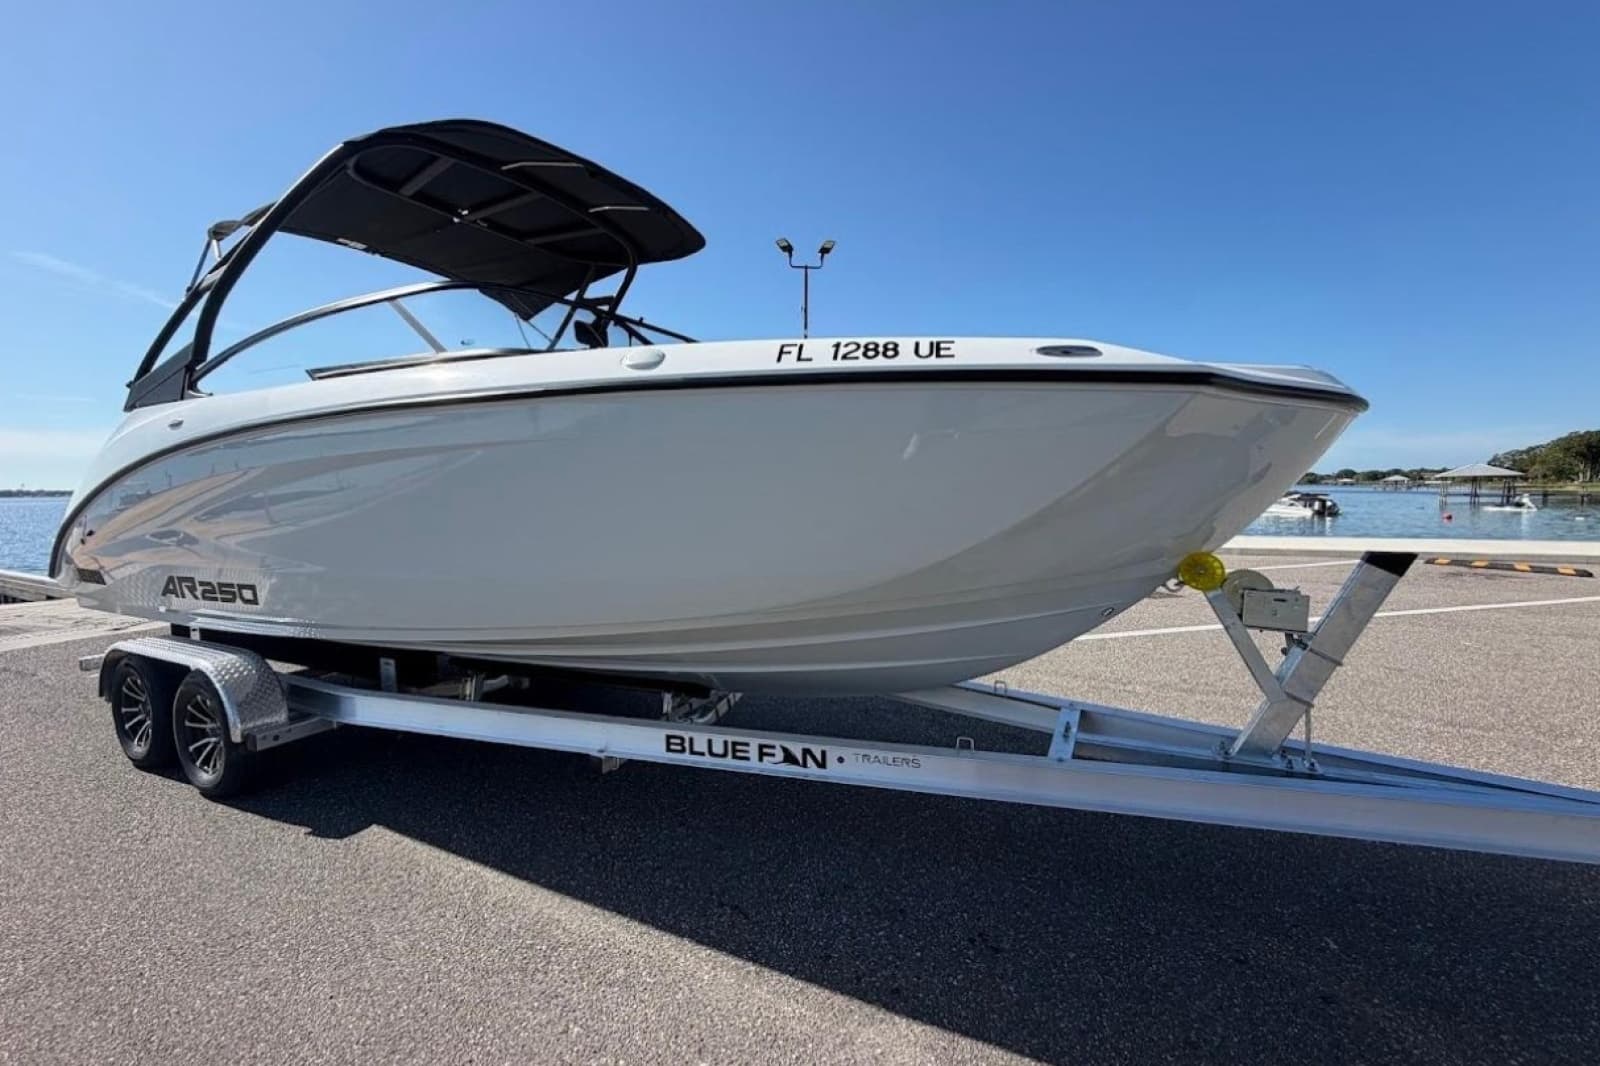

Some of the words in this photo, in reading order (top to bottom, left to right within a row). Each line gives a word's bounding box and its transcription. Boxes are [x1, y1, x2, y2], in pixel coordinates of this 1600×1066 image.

[776, 343, 813, 363] FL
[831, 341, 900, 361] 1288
[913, 340, 956, 359] UE
[161, 575, 260, 605] AR250
[665, 734, 751, 761] BLUE
[852, 752, 922, 769] TRAILERS
